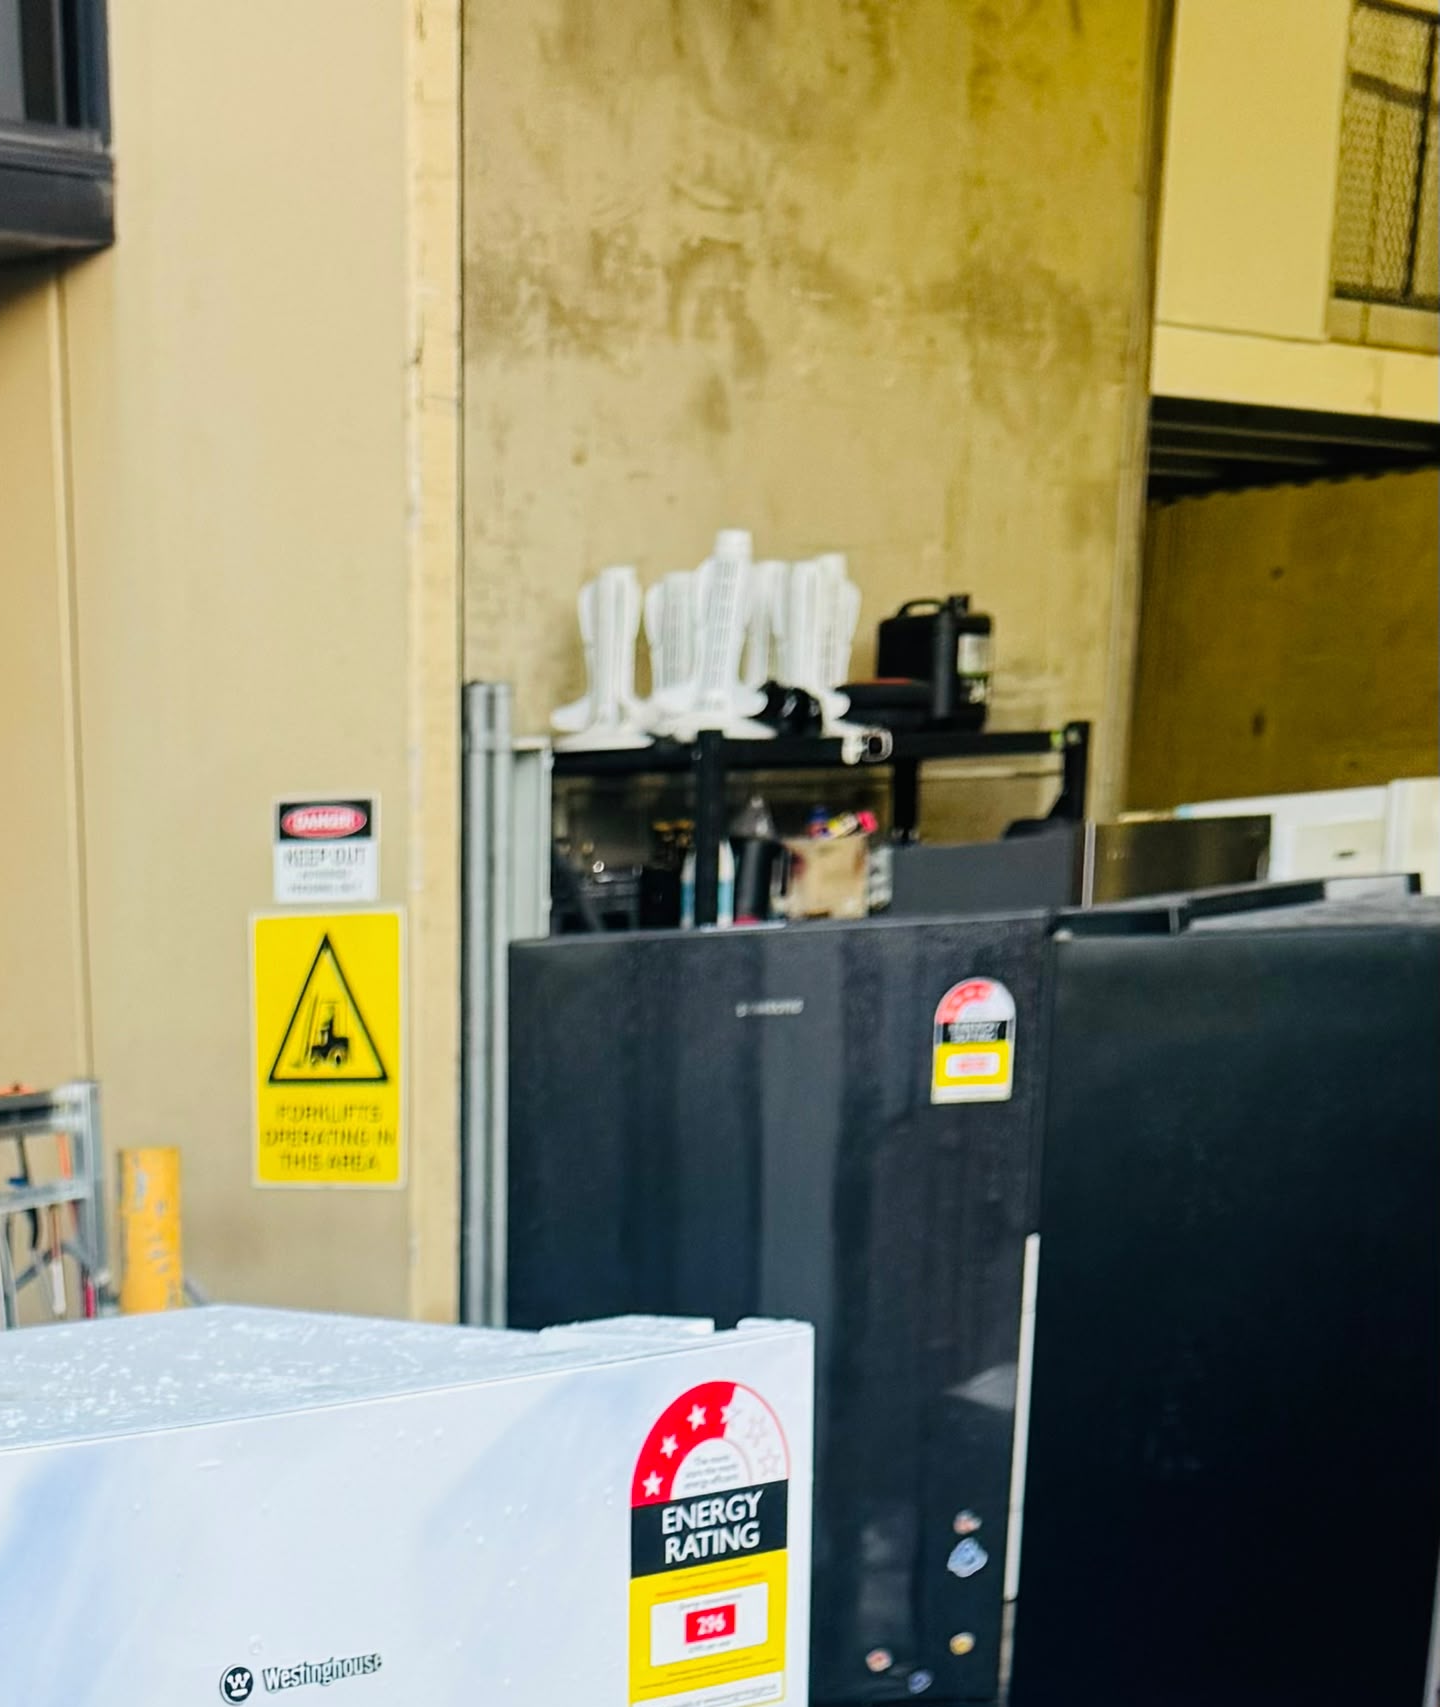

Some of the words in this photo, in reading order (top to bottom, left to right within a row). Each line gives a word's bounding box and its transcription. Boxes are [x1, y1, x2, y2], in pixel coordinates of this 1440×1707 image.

[276, 1104, 382, 1123] FORKLIFTS
[264, 1128, 370, 1147] OPERATING
[280, 1152, 321, 1172] THIS
[327, 1152, 380, 1172] AREA
[662, 1489, 764, 1535] ENERGY
[665, 1521, 760, 1564] RATING
[262, 1653, 383, 1693] Westinghouse
